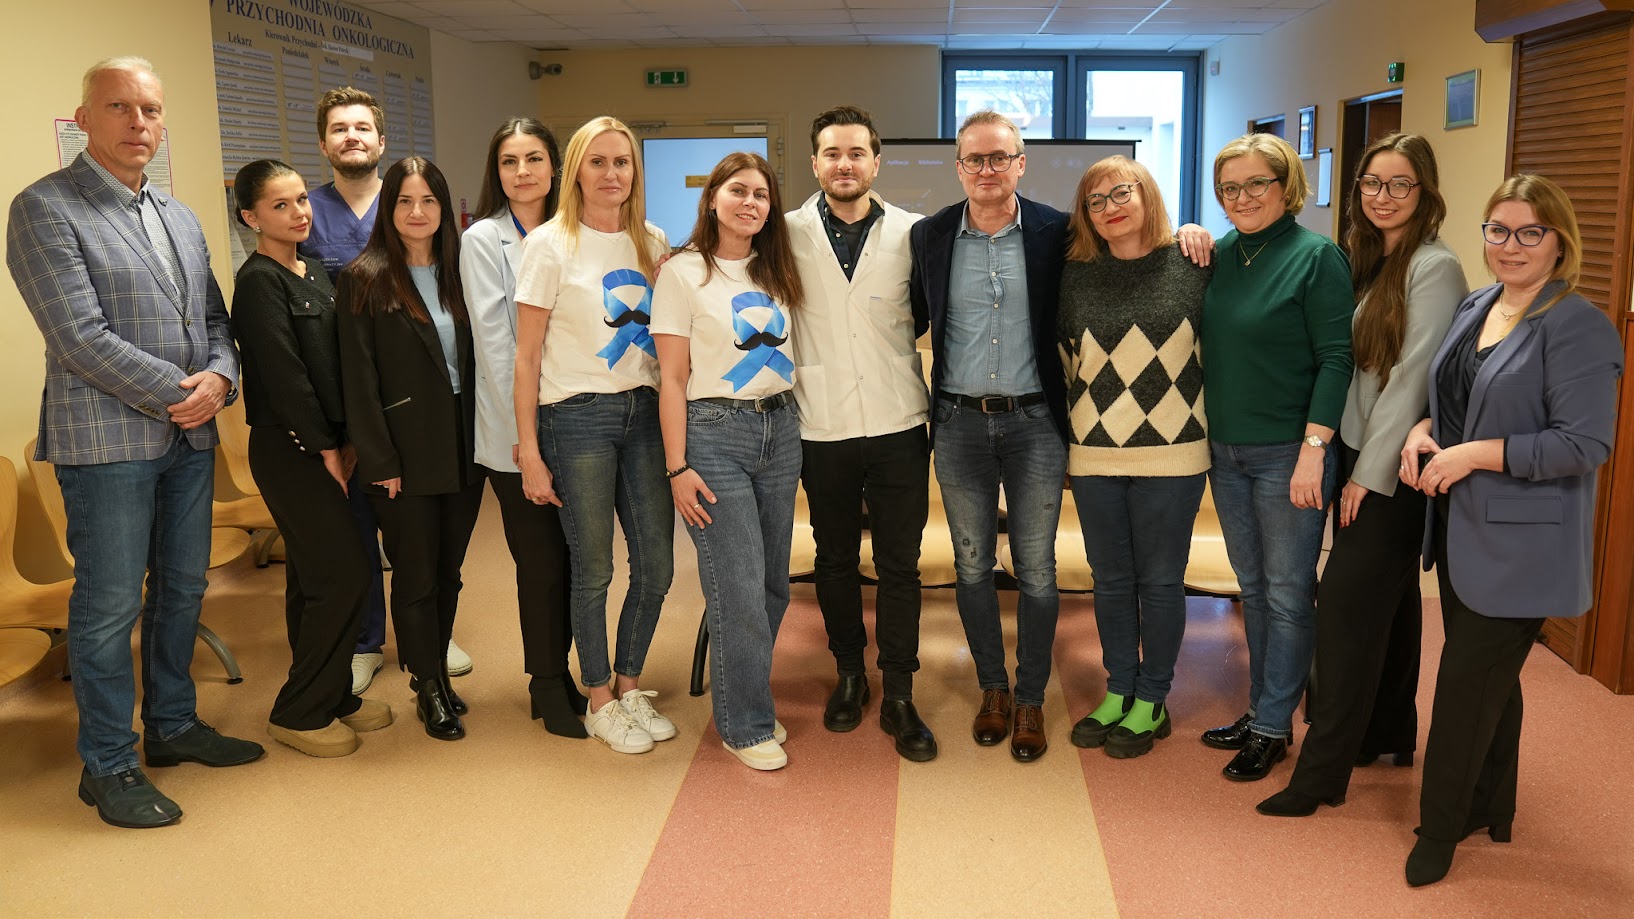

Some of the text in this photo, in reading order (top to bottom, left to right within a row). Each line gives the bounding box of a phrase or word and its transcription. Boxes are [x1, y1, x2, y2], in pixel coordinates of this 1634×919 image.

[289, 0, 373, 29] WOJEWÓDZKA
[226, 0, 415, 59] PRZYCHODNIA ONKOLOGICZNA
[228, 31, 252, 47] Lekarz
[265, 29, 290, 42] Kierownik
[292, 36, 318, 49] Przychodni
